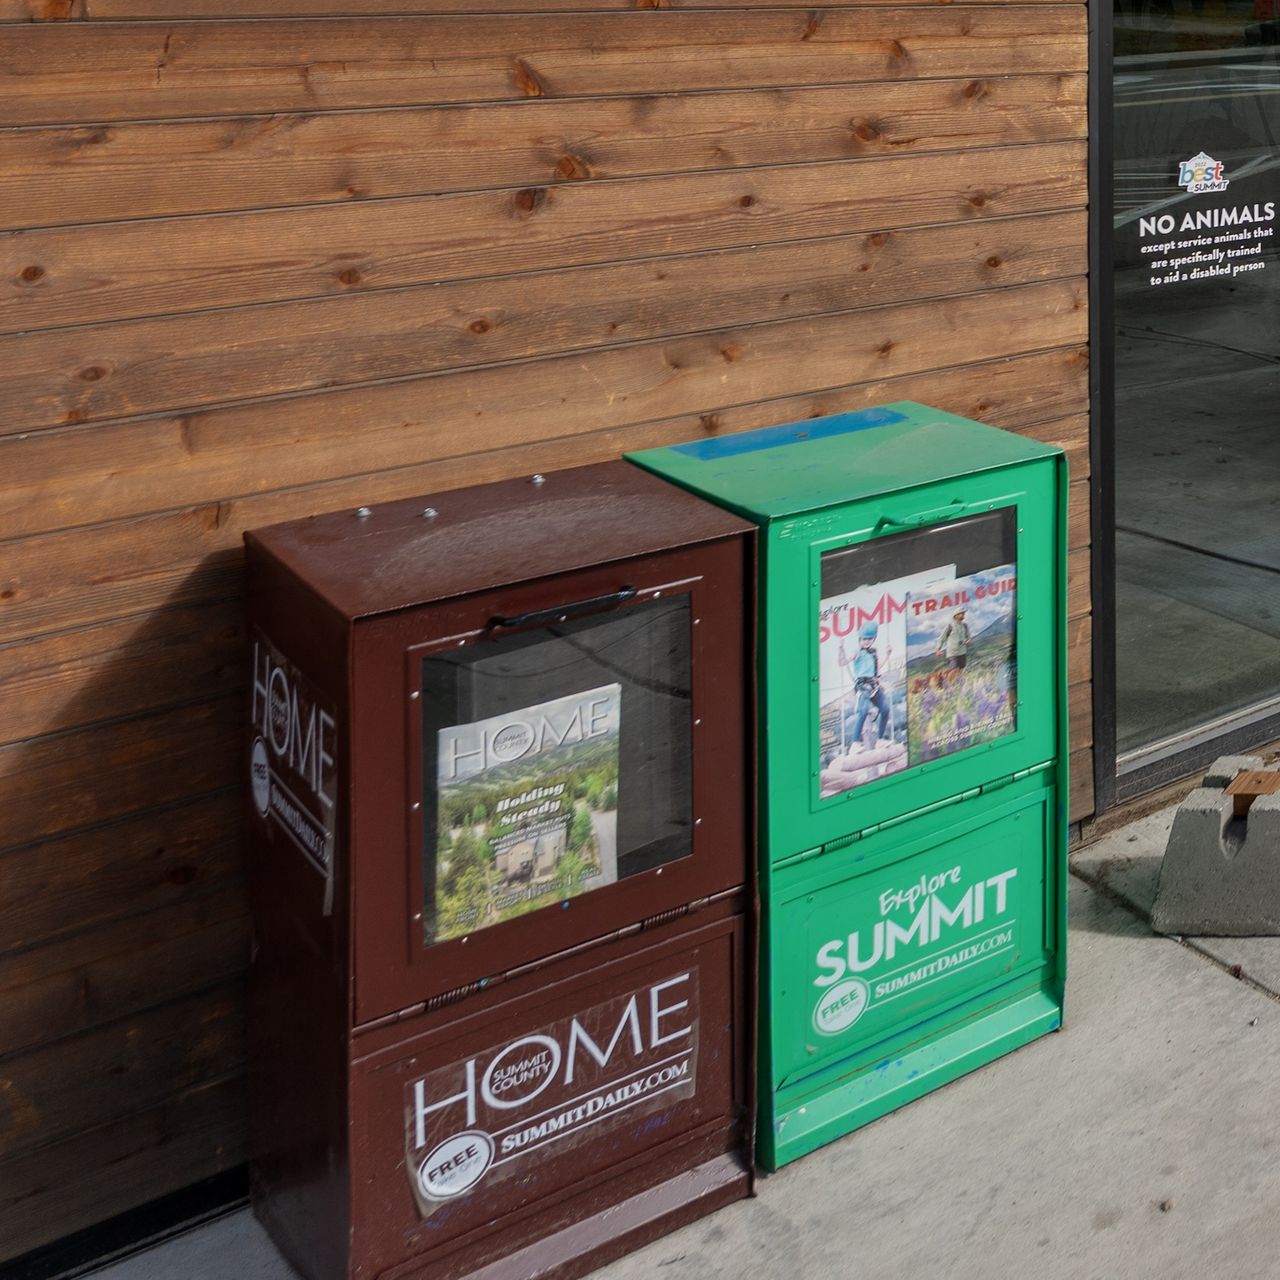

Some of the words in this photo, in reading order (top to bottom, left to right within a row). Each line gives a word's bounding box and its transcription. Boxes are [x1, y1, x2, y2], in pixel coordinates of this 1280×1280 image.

[1180, 162, 1222, 184] best
[1194, 181, 1228, 192] SUMMIT
[1139, 214, 1175, 237] NO
[1179, 202, 1275, 232] ANIMALS
[1141, 240, 1175, 255] except
[1177, 235, 1212, 248] service
[1214, 229, 1251, 244] animals
[1253, 227, 1274, 237] that
[1151, 259, 1168, 269] are
[1169, 248, 1226, 269] specifically
[1227, 243, 1262, 258] trained
[1150, 276, 1161, 286] to
[1163, 271, 1180, 284] aid
[1182, 272, 1188, 281] a
[1190, 263, 1231, 280] disabled
[1232, 261, 1265, 277] person
[912, 590, 971, 616] TRAIL
[974, 576, 1017, 600] GUID
[819, 591, 907, 645] SUMM
[252, 642, 335, 809] HOME
[450, 697, 609, 779] HOME
[496, 783, 564, 813] Holding
[500, 799, 561, 827] Steady
[879, 866, 961, 916] Explore
[813, 868, 1017, 987] SUMMIT
[822, 988, 858, 1019] FREE
[415, 973, 692, 1149] HOME
[491, 1060, 552, 1095] COUNTY
[493, 1050, 549, 1083] SUMMIT
[428, 1143, 479, 1182] FREE
